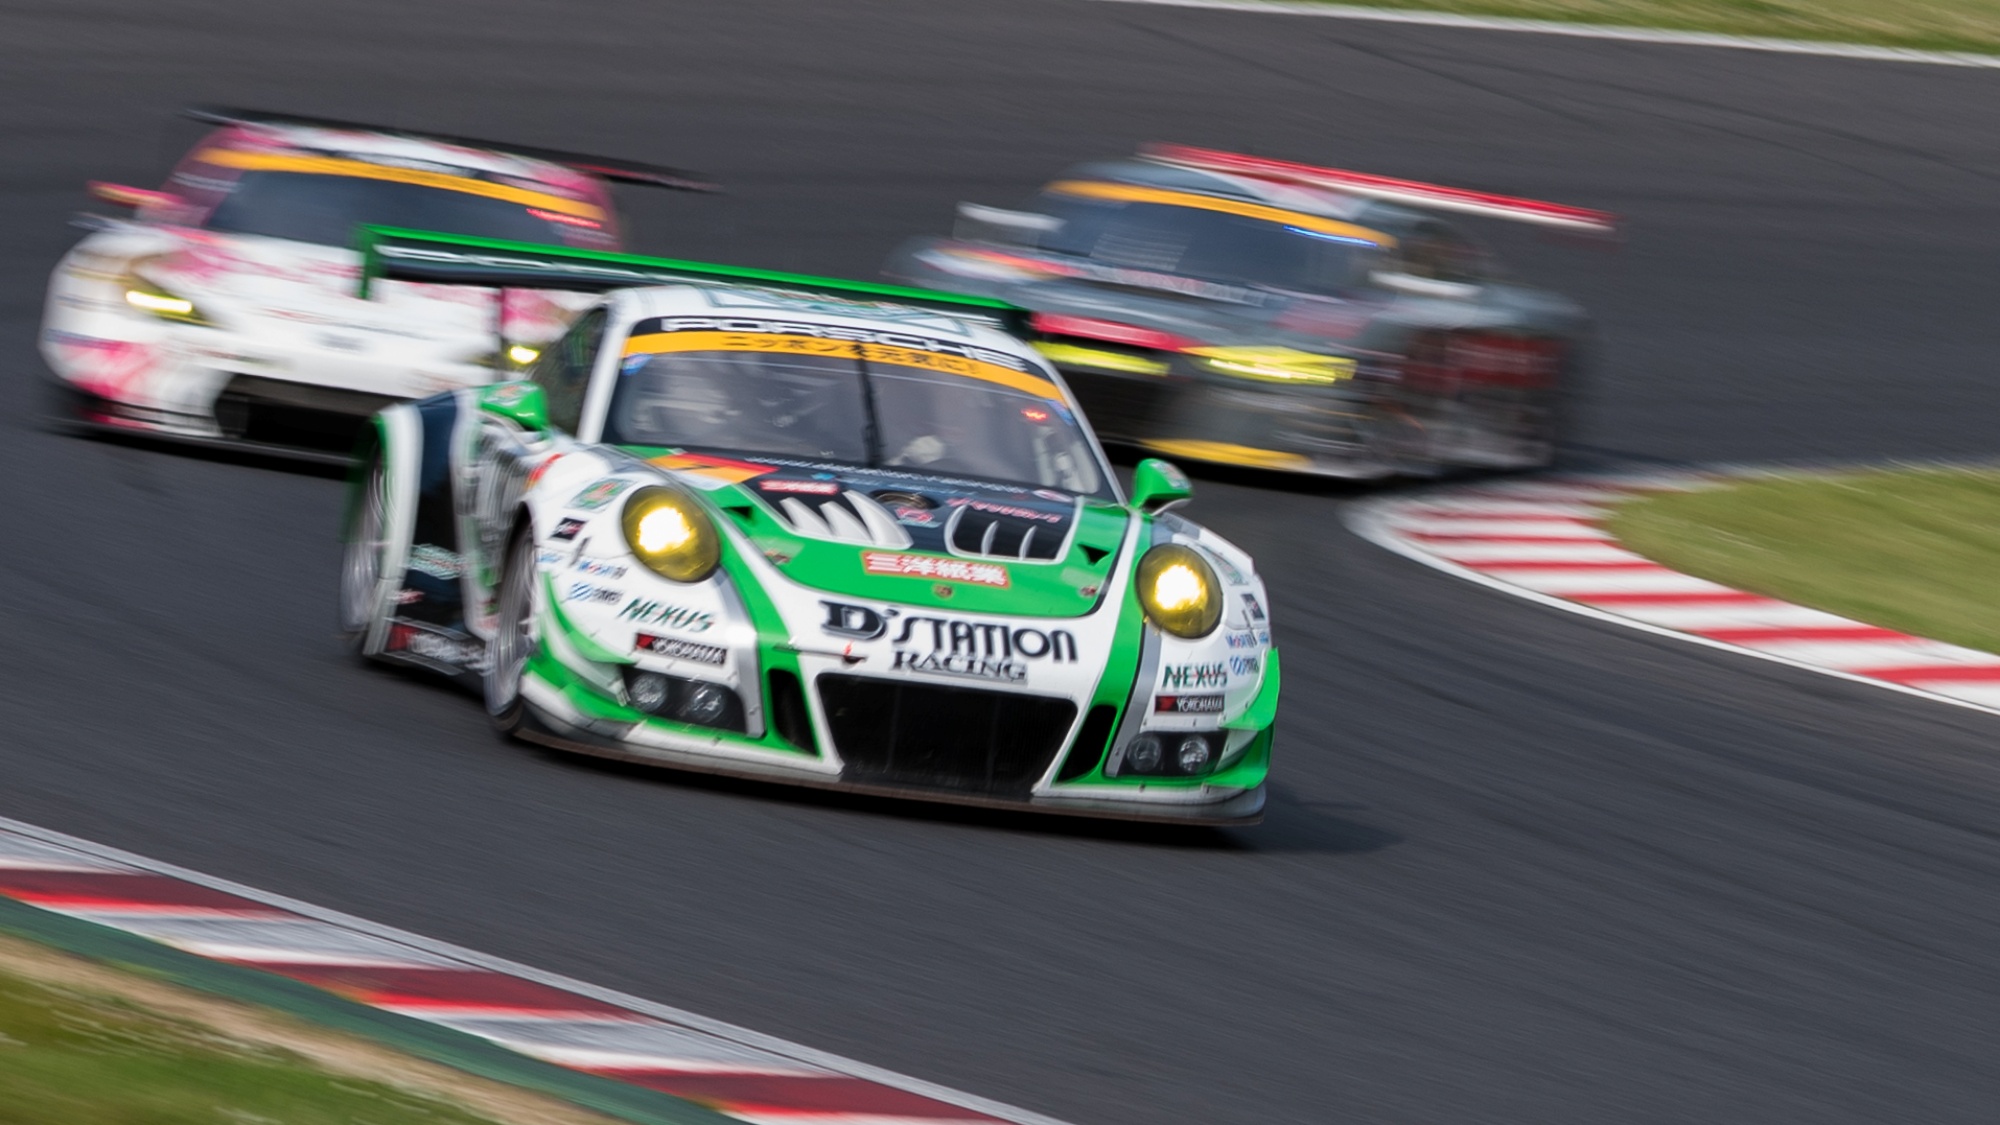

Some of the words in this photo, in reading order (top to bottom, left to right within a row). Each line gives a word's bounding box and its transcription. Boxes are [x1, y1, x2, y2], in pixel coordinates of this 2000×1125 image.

[660, 317, 1027, 372] PORSCHE
[617, 597, 716, 633] NEXUS
[889, 650, 1029, 684] RACING
[1162, 661, 1228, 690] NEXUS
[1176, 693, 1224, 713] YOKOHAMA
